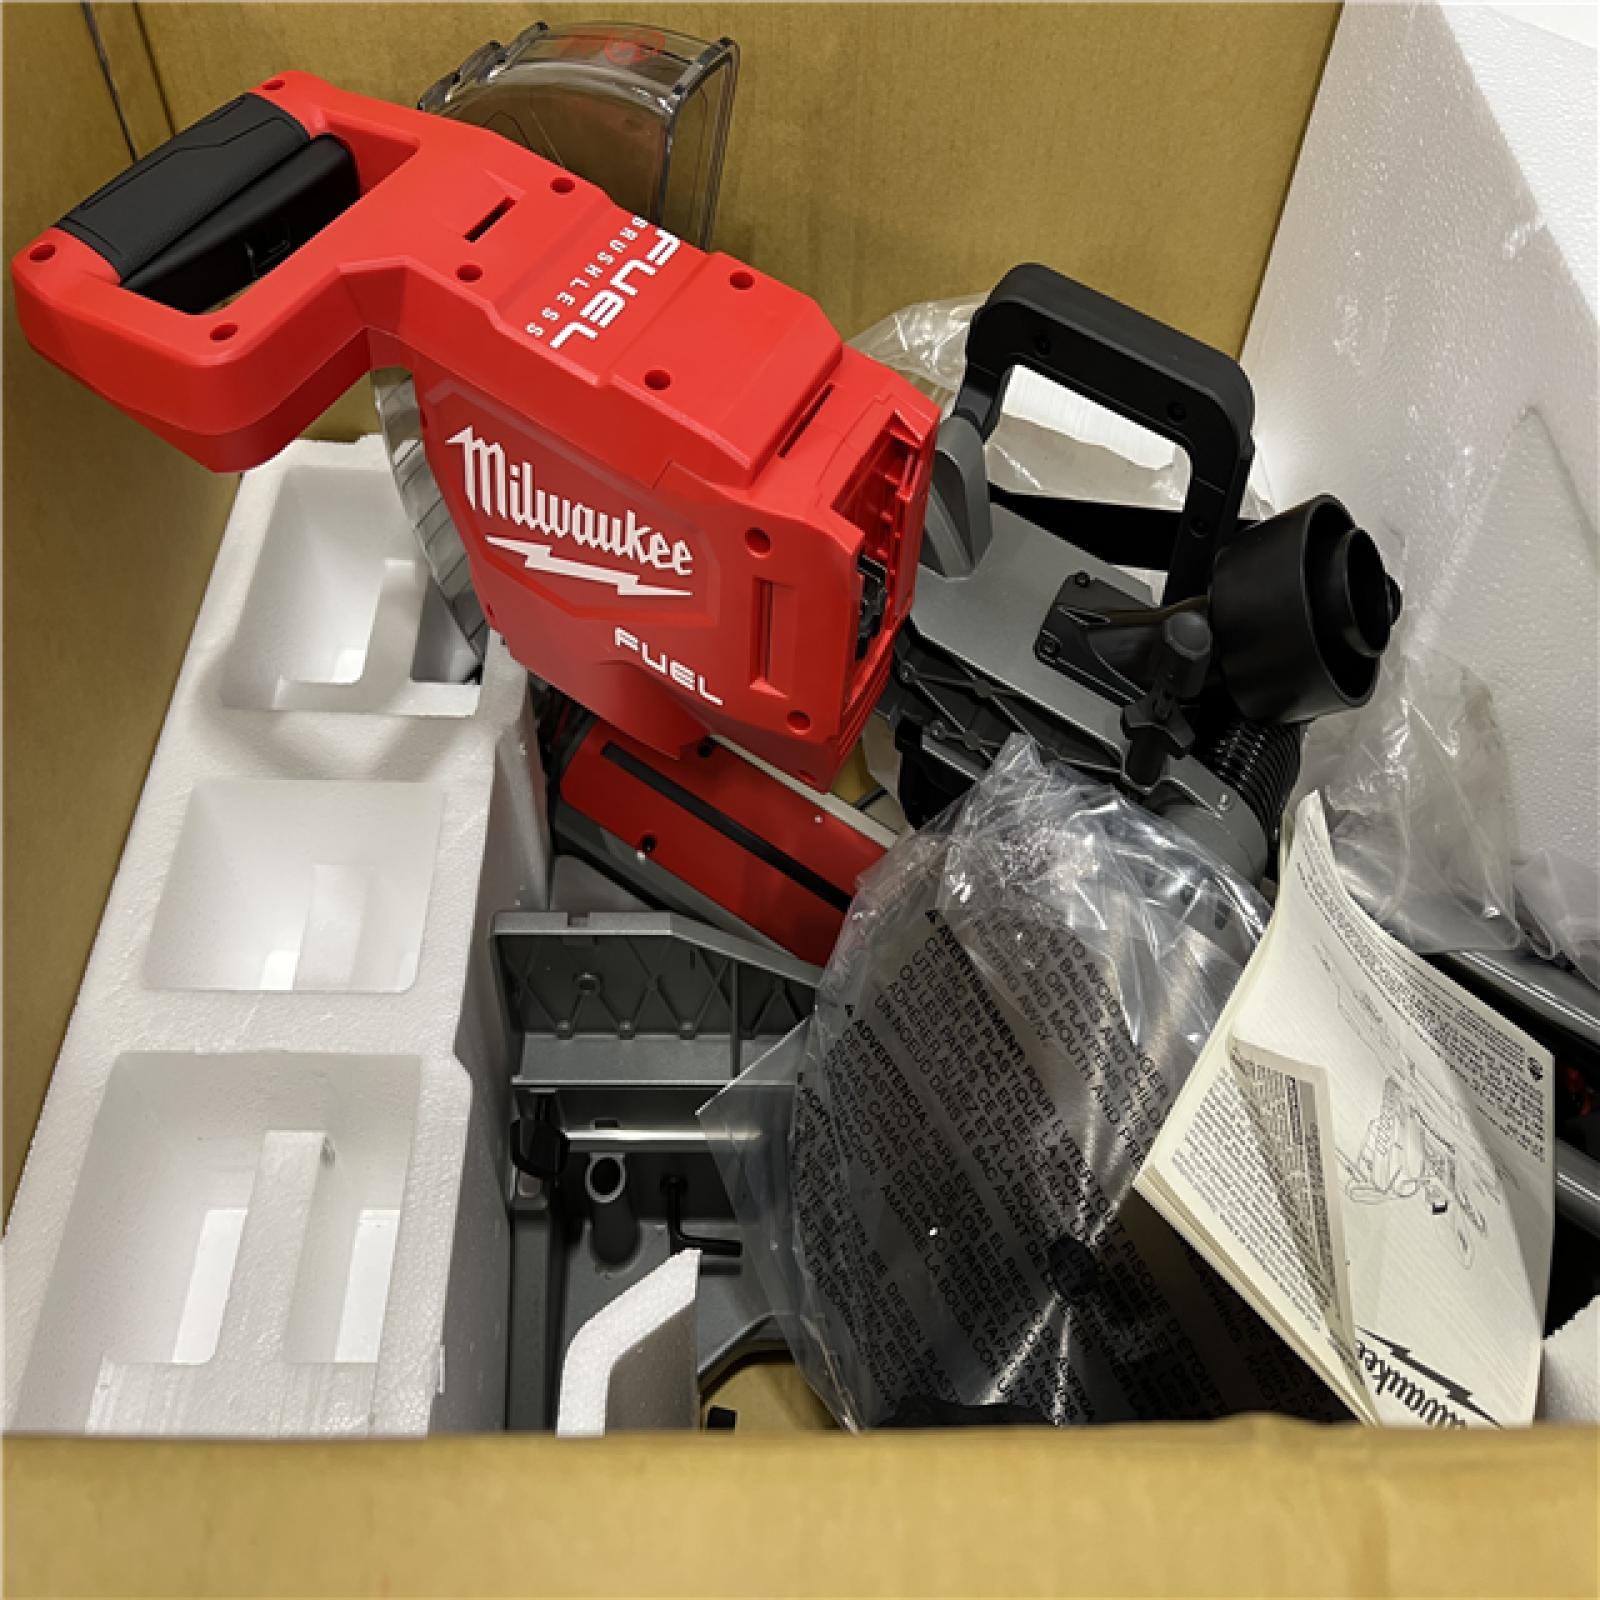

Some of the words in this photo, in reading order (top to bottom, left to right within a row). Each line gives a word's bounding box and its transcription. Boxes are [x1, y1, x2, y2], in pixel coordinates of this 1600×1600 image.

[525, 215, 649, 338] BRUSHLESS
[549, 227, 682, 349] FUEL
[445, 424, 693, 576] Milwaukee
[614, 626, 723, 706] FUEL
[909, 949, 963, 1024] UTILISER
[954, 1022, 979, 1051] CE
[971, 1049, 1001, 1088] SAC
[993, 1086, 1017, 1116] EN
[922, 935, 947, 962] CE
[938, 961, 970, 1001] SAC
[961, 999, 986, 1027] EN
[977, 1025, 1043, 1128] PLASTIQUE
[1020, 968, 1053, 1009] AND
[1047, 1008, 1096, 1081] MOUTH
[1089, 1083, 1123, 1126] AND
[1043, 970, 1069, 1000] OR
[1056, 956, 1105, 1027] BABIES
[1097, 1024, 1129, 1065] AND
[1080, 959, 1124, 1018] AVOID
[896, 963, 922, 992] OU
[915, 990, 945, 1026] LES
[974, 1085, 1000, 1116] CE
[991, 1114, 1020, 1154] SAC
[936, 1054, 960, 1082] AU
[951, 1079, 980, 1115] NEZ
[972, 1114, 994, 1138] ET
[995, 1155, 1019, 1182] LA
[871, 993, 897, 1020] UN
[927, 1073, 964, 1122] DANS
[956, 1120, 979, 1146] LE
[971, 1143, 999, 1181] SAC
[992, 1182, 1032, 1239] AVANT
[1023, 1239, 1047, 1270] DE
[904, 1127, 946, 1181] LEJOS
[937, 1179, 961, 1206] DE
[953, 1205, 983, 1243] LOS
[925, 1127, 960, 1172] PARA
[952, 1170, 995, 1232] EVITAR
[987, 1231, 1009, 1256] EL
[1019, 1063, 1058, 1117] POUR
[1120, 1239, 1173, 1316] RISQUE
[868, 1135, 899, 1171] TAN
[942, 1253, 988, 1318] PUEDE
[904, 1158, 955, 1229] CARROS
[947, 1227, 965, 1245] O
[879, 1182, 930, 1252] AMARRE
[922, 1251, 944, 1278] LA
[935, 1275, 979, 1339] BOLSA
[970, 1335, 1001, 1378] CON
[884, 1278, 928, 1345] DIESEN
